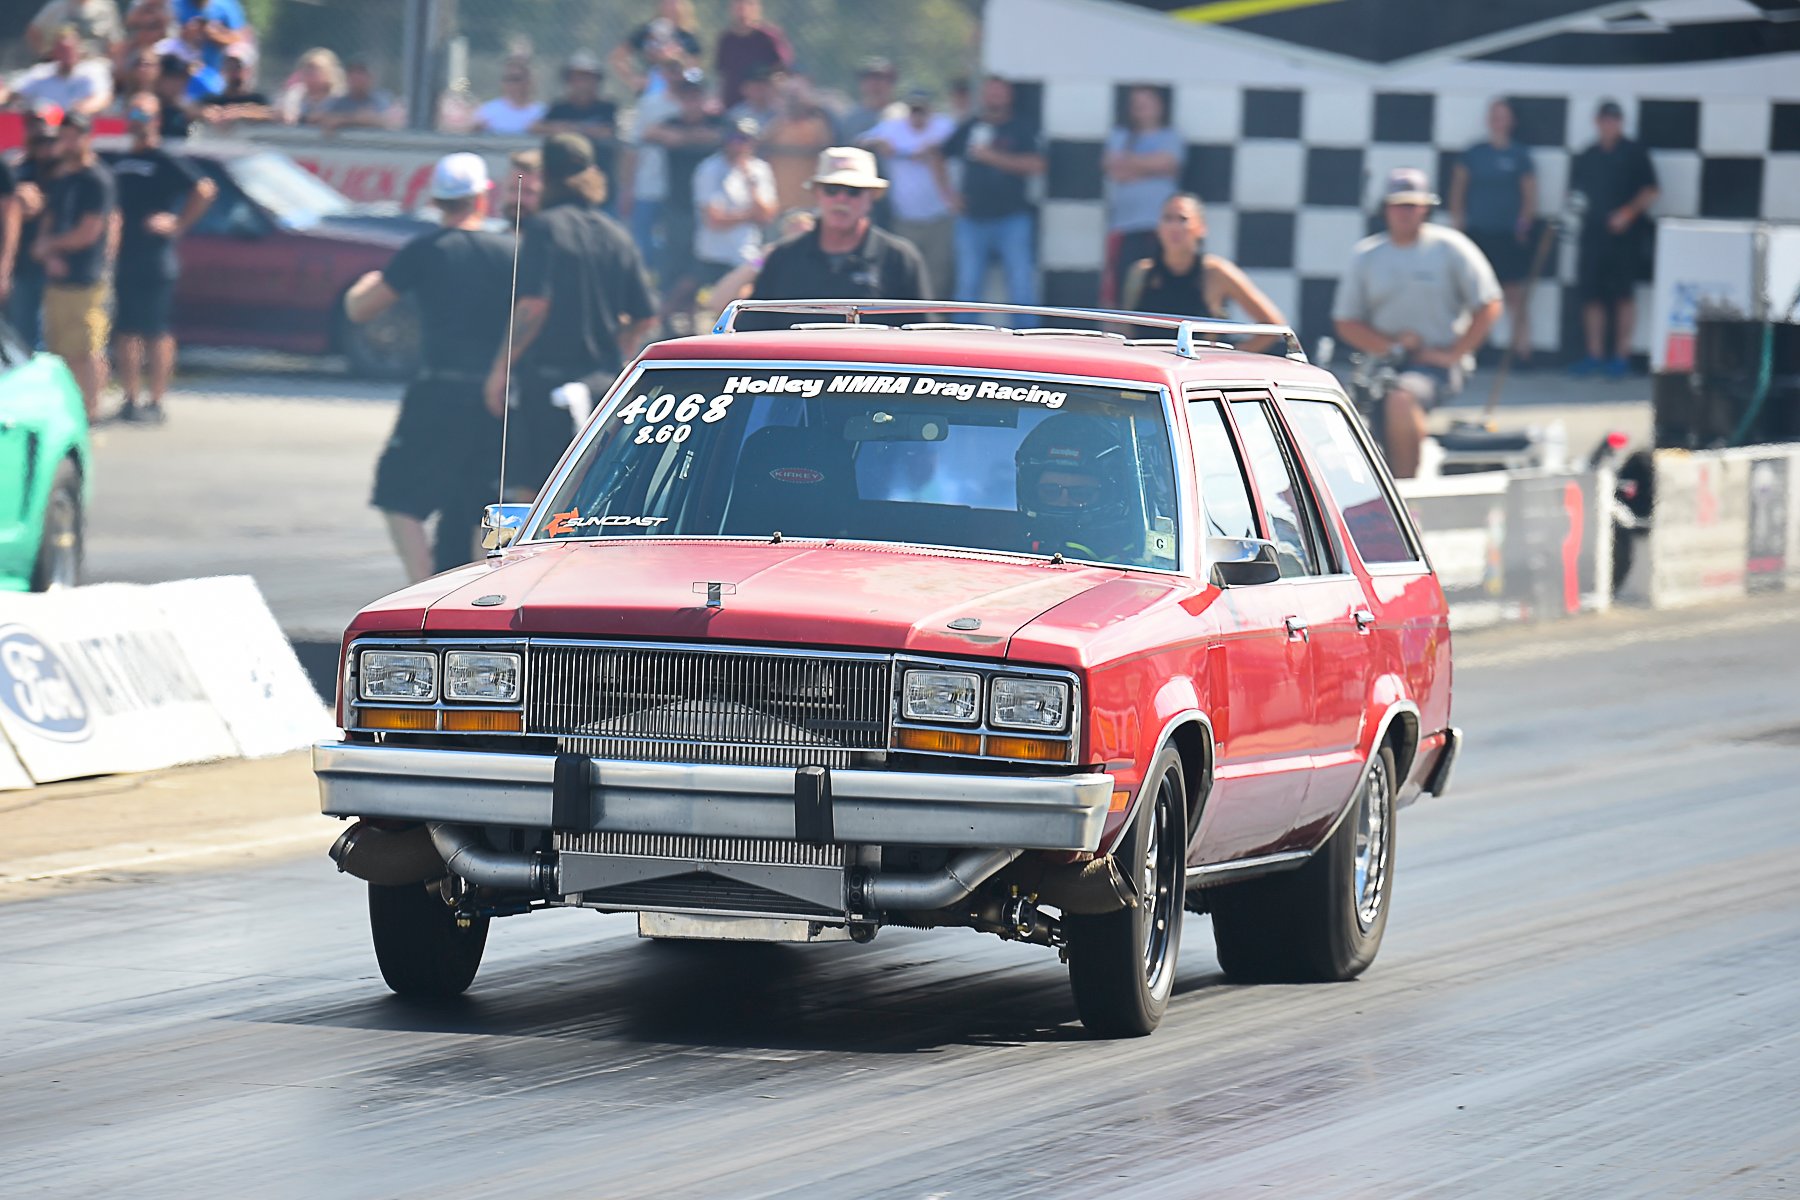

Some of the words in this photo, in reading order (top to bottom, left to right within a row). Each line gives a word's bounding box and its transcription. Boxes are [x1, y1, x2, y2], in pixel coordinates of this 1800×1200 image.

[723, 376, 824, 397] Holley
[827, 376, 911, 394] NMRA
[912, 378, 977, 401] Drag
[976, 382, 1067, 409] Racing
[617, 393, 734, 425] 4068
[634, 424, 692, 445] 8.60
[563, 516, 669, 527] SUNCOAST
[1156, 538, 1164, 549] G
